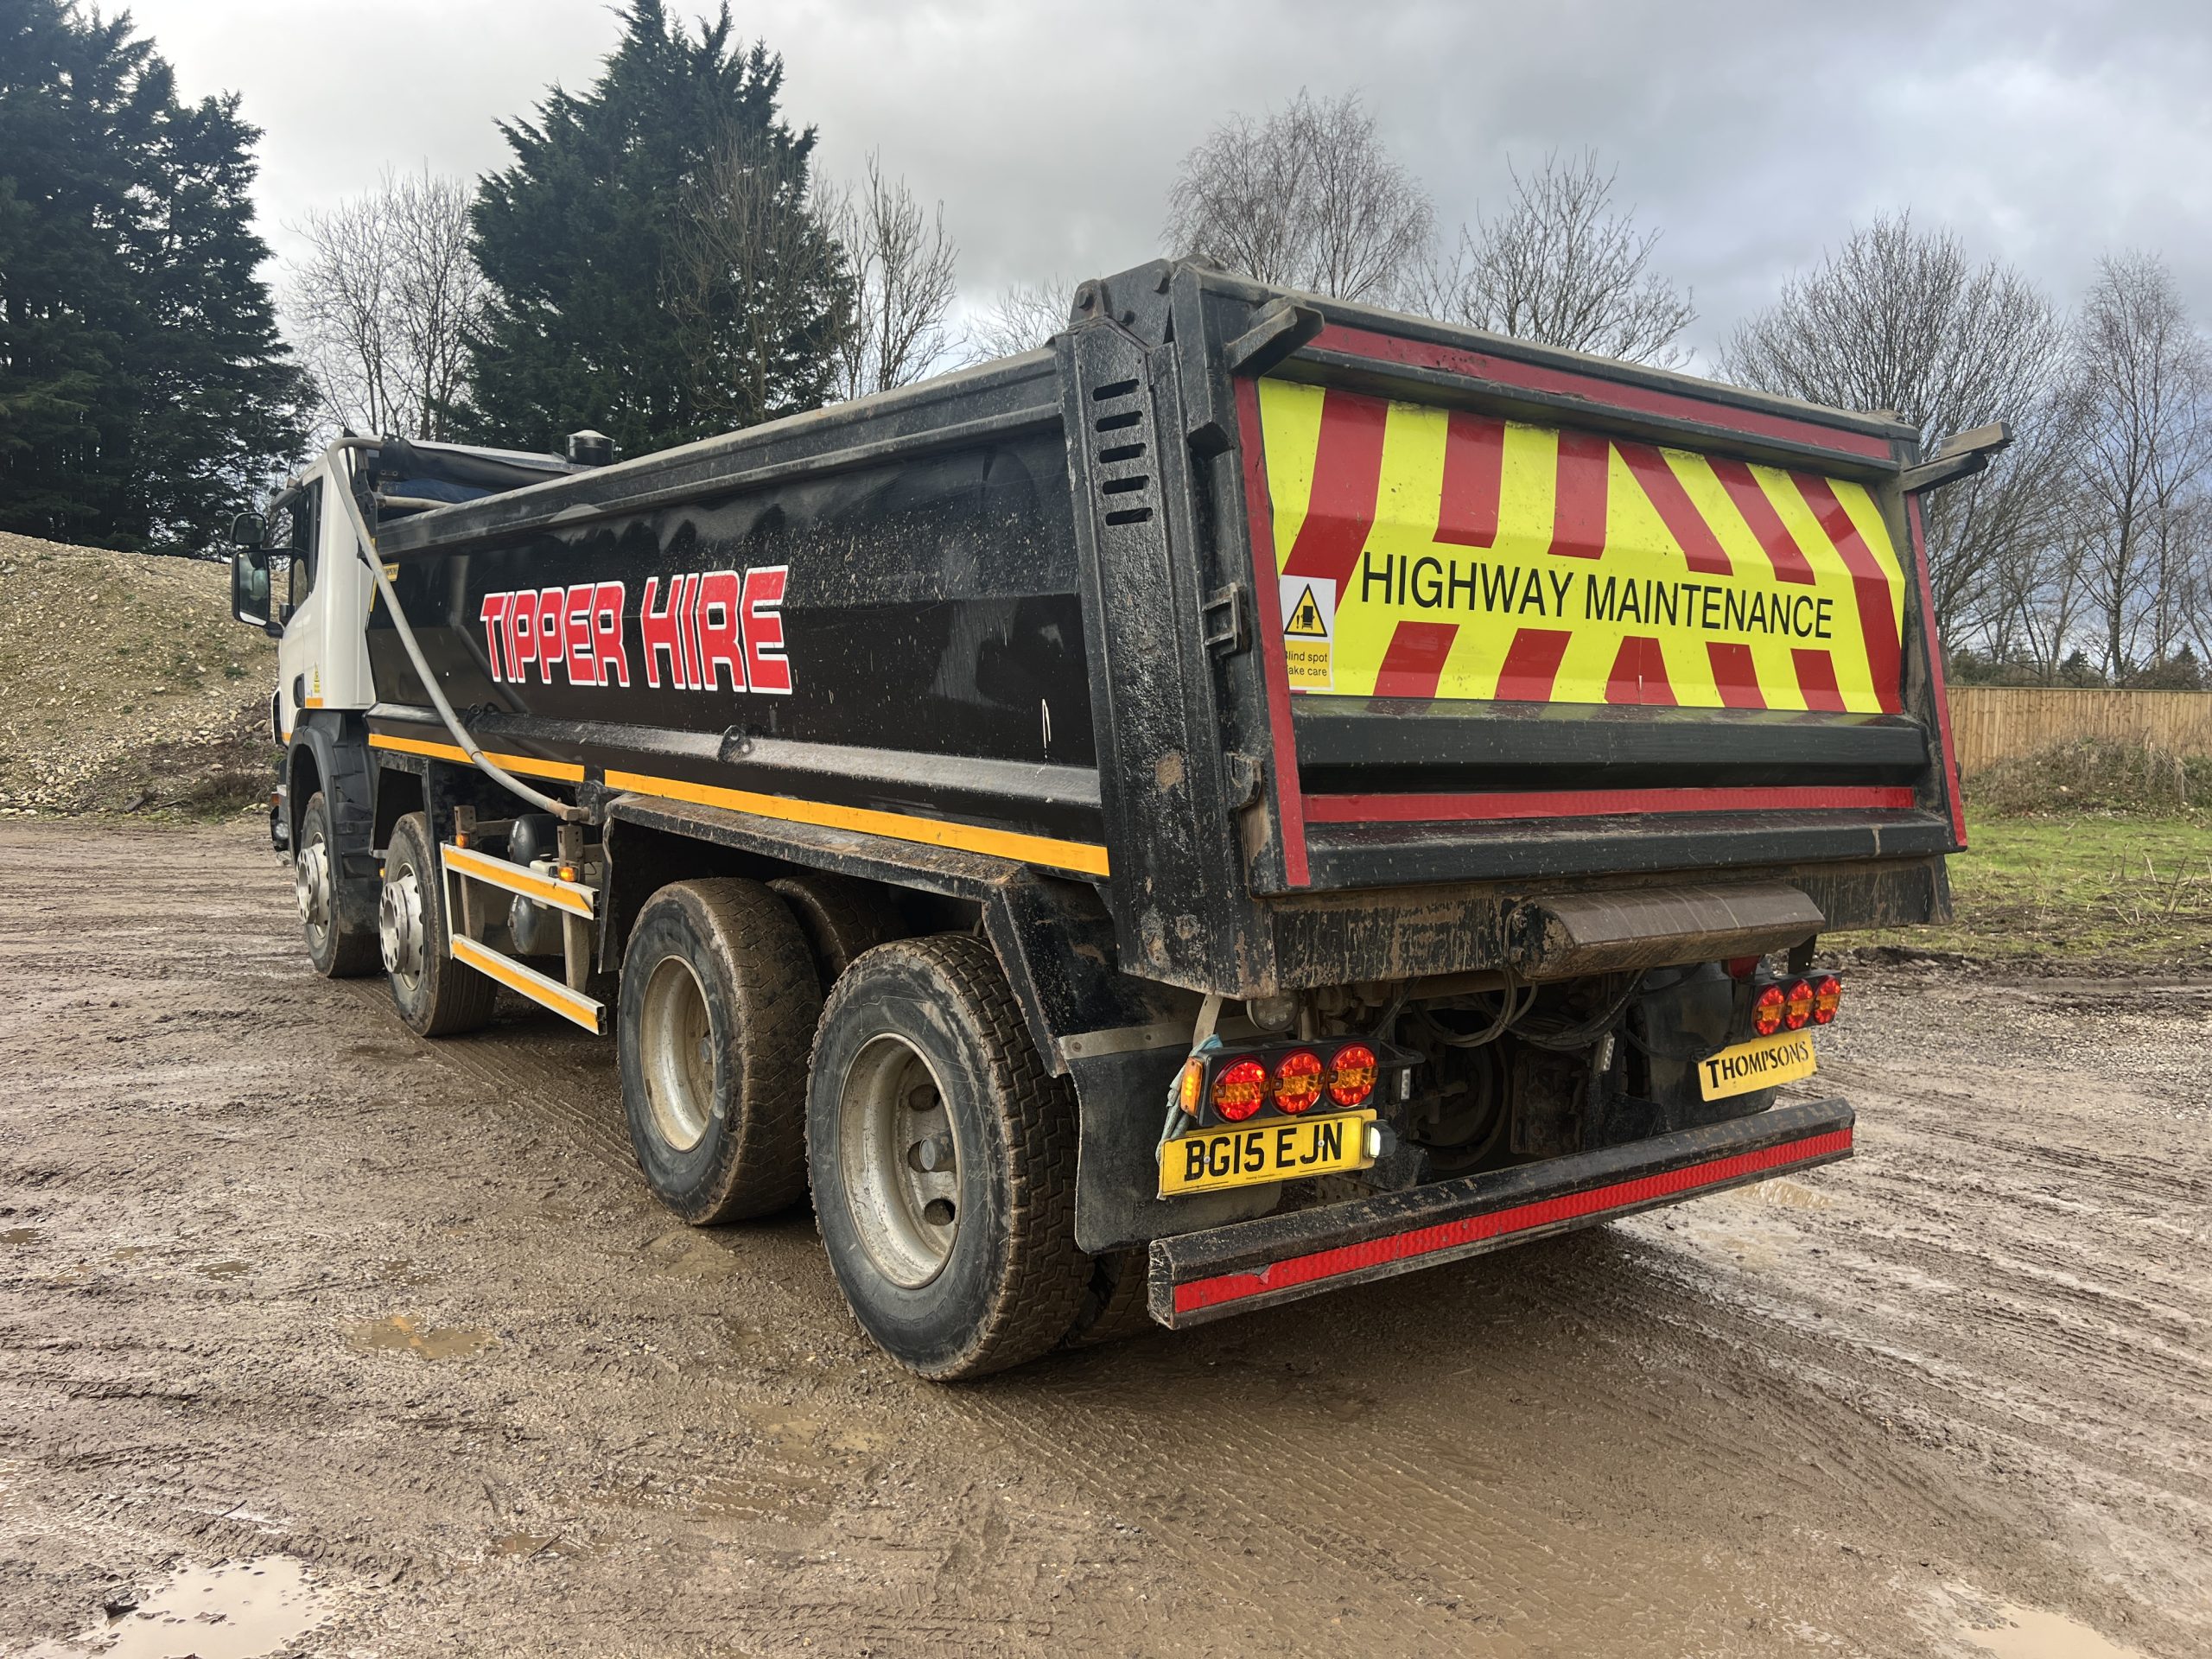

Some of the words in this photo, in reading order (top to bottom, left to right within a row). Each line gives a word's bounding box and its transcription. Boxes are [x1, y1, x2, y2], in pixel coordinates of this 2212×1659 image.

[1362, 551, 1573, 620] HIGHWAY
[1585, 574, 1834, 639] MAINTENANCE
[480, 581, 630, 688] TIPPER
[640, 565, 792, 695] HIRE
[1287, 664, 1305, 676] ake
[1307, 666, 1328, 677] care
[1307, 652, 1328, 664] spot
[1706, 1040, 1808, 1089] THOMPSONS
[1184, 1131, 1265, 1181] BG15
[1276, 1122, 1343, 1168] EJN
